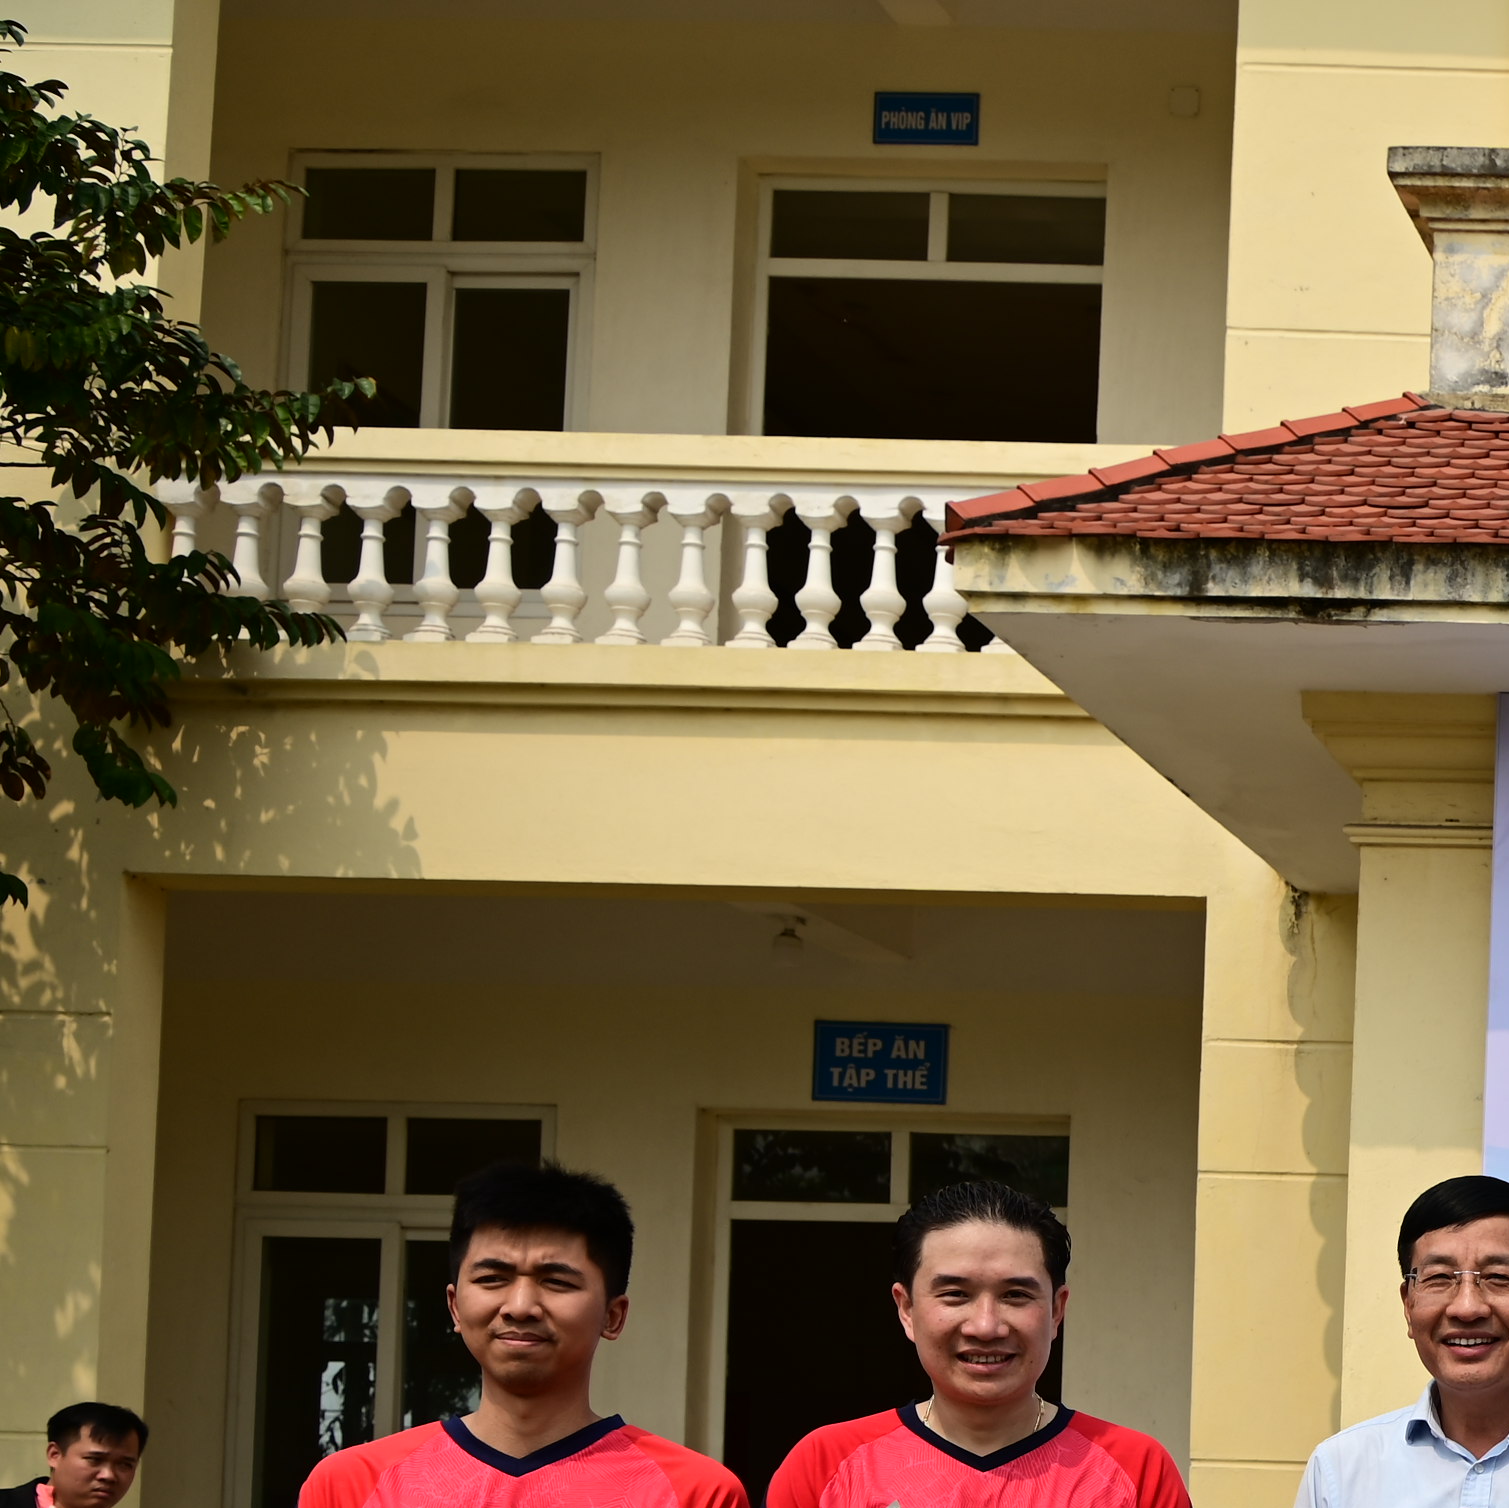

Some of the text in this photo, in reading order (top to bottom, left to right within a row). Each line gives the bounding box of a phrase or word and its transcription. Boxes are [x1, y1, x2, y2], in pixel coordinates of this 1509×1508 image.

[951, 112, 971, 130] VIP
[835, 1032, 925, 1059] BẾP ĂN
[830, 1062, 930, 1092] TẬP THỂ
